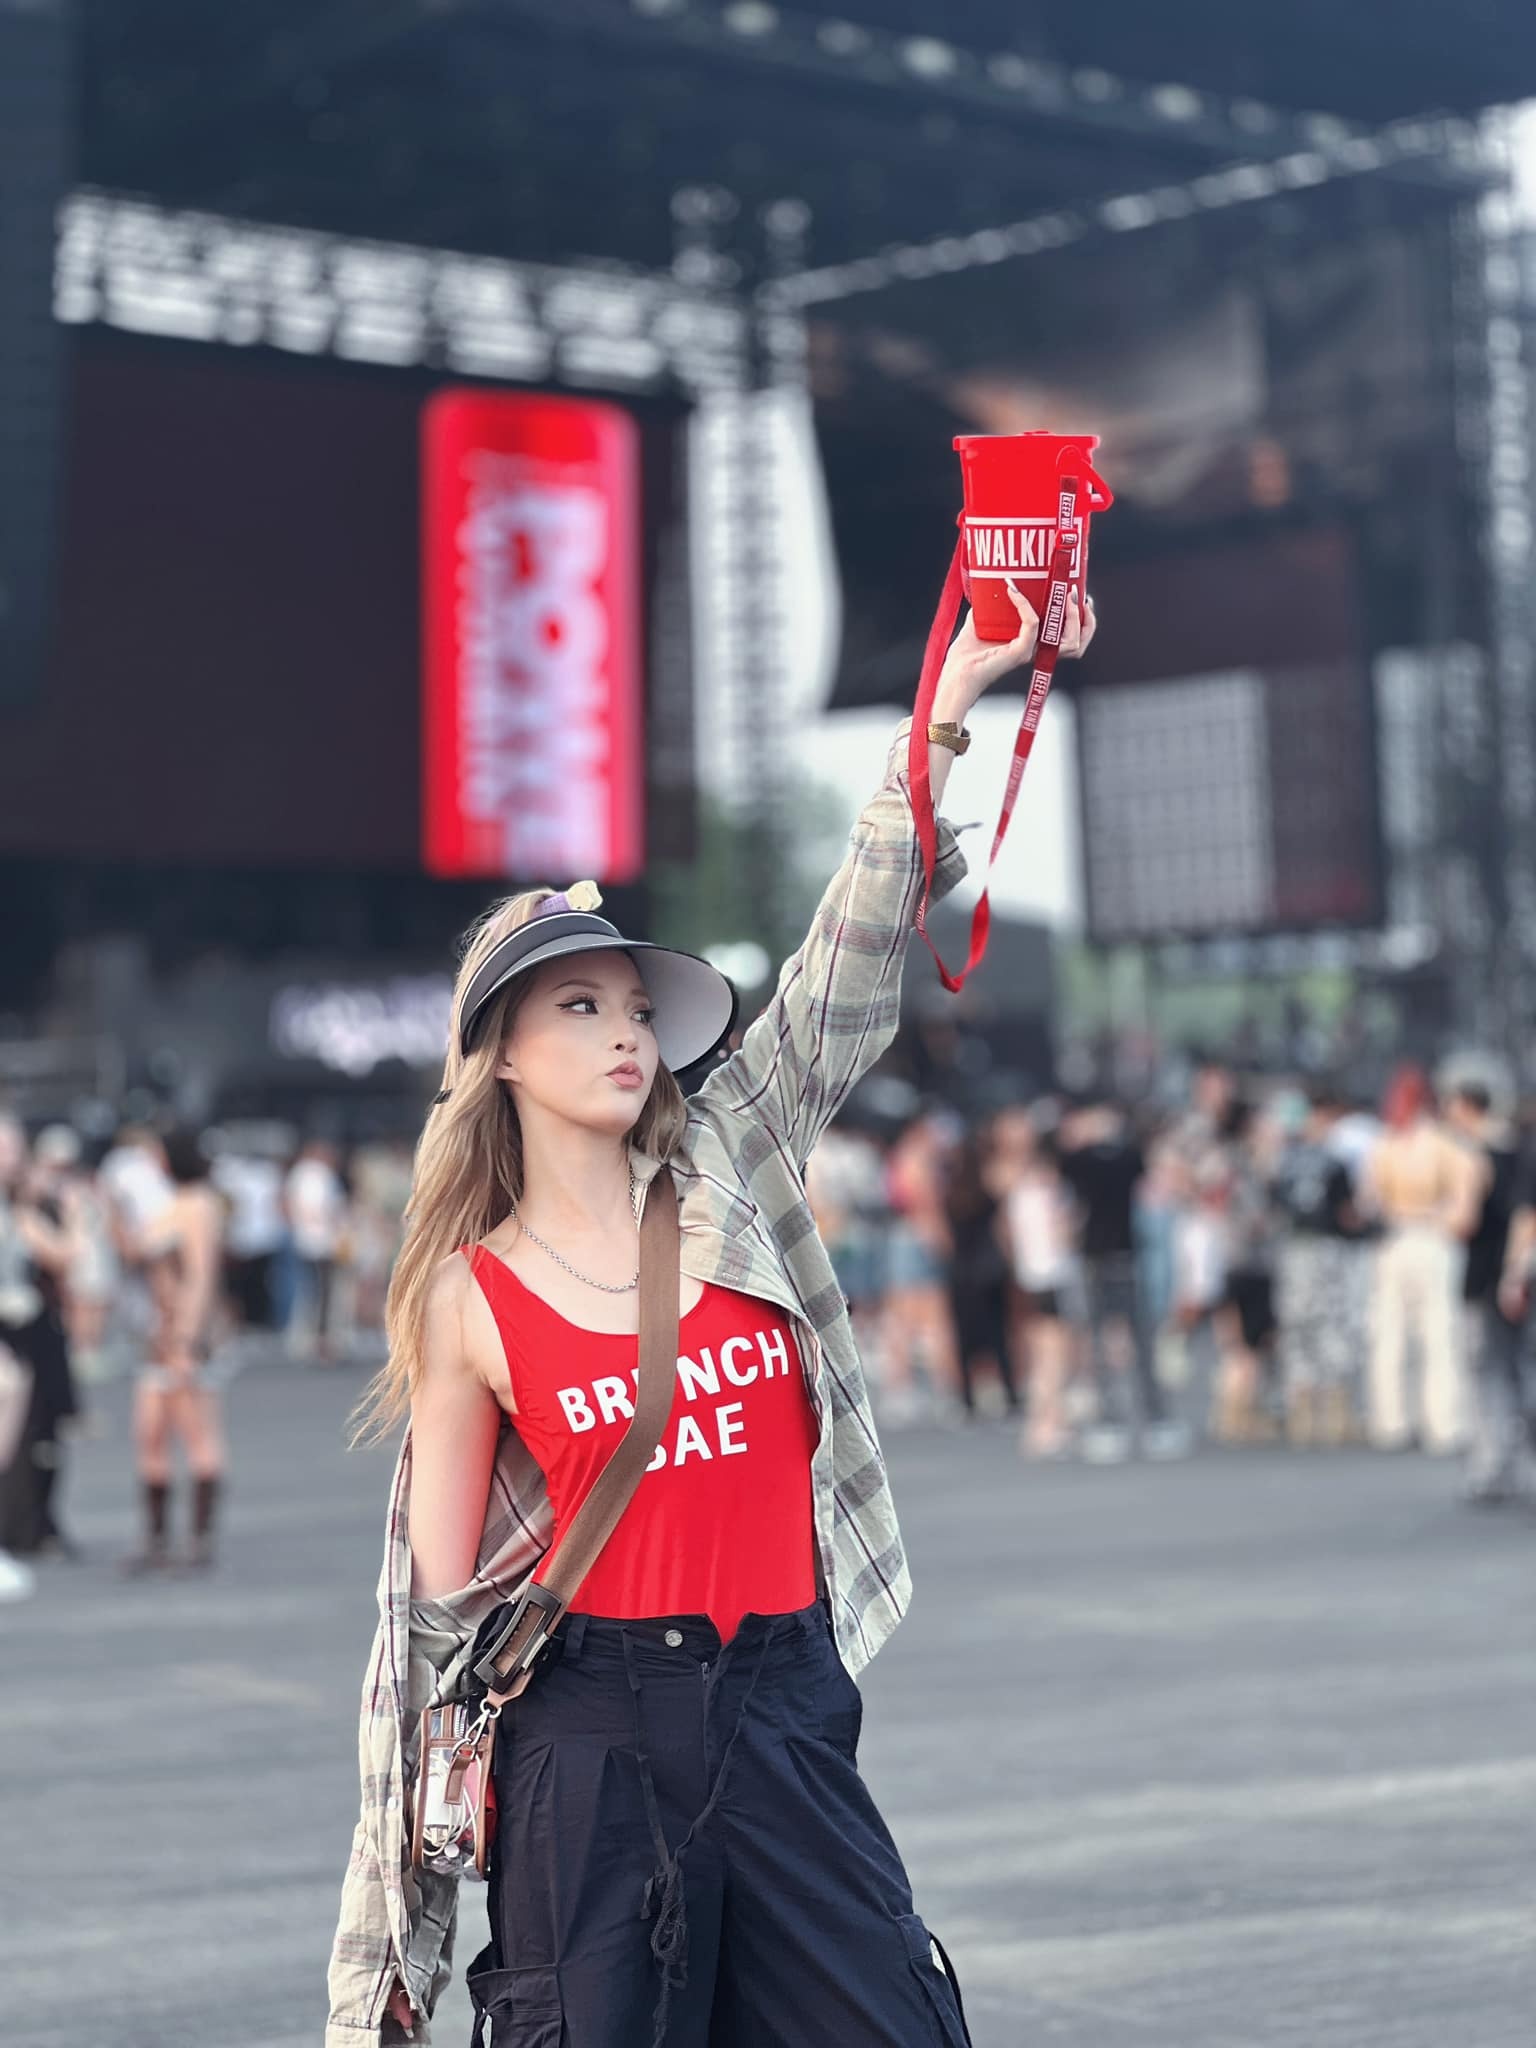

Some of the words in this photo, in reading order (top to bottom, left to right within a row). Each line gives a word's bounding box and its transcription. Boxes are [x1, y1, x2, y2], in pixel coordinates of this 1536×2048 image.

[1061, 496, 1072, 517] KEEP
[973, 528, 1075, 566] WALKI
[1053, 584, 1064, 605] KEEP
[1045, 604, 1062, 642] WALKING
[1034, 674, 1048, 696] KEEP
[556, 1328, 789, 1434] BRNCH
